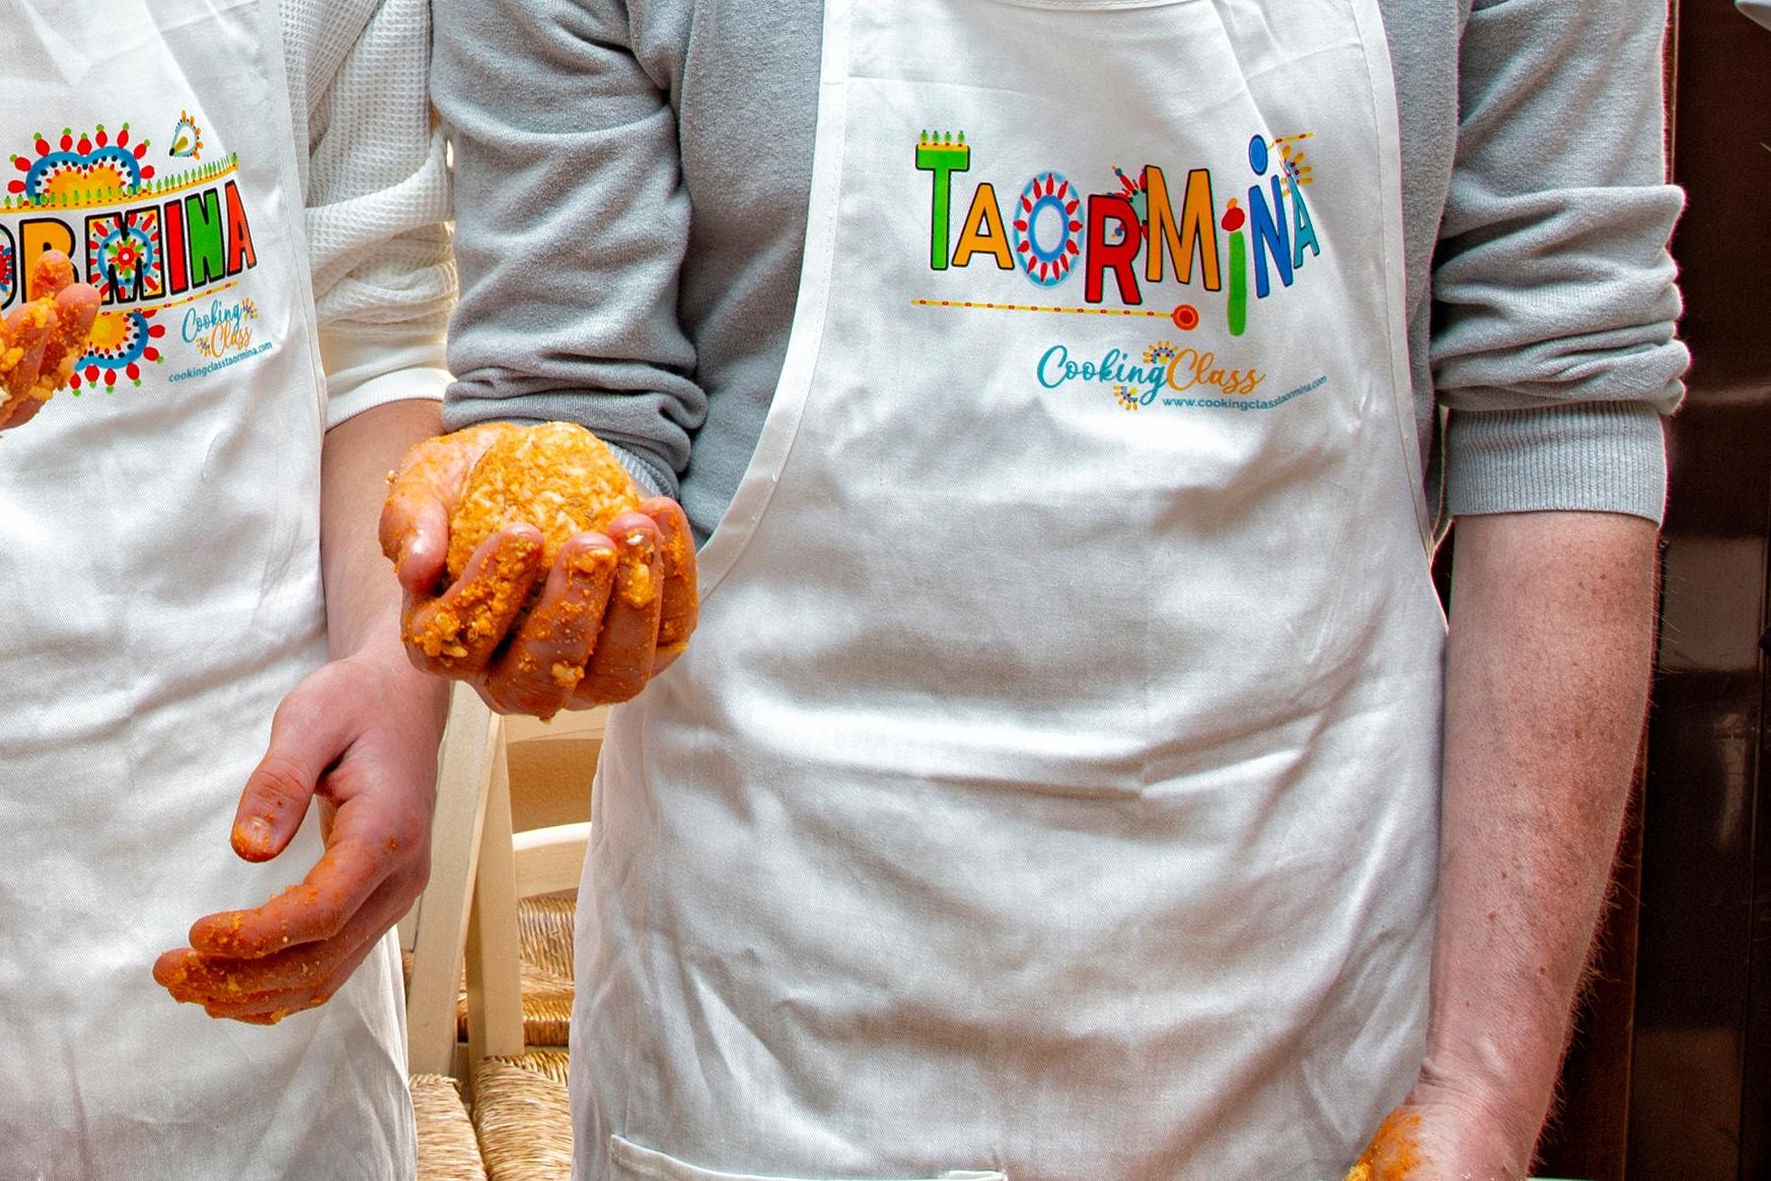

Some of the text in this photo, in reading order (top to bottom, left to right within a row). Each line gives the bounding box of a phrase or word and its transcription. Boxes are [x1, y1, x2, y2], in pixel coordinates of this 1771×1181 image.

[181, 299, 242, 344] Cooking
[211, 319, 253, 359] Class
[1036, 344, 1267, 407] Cooking Class
